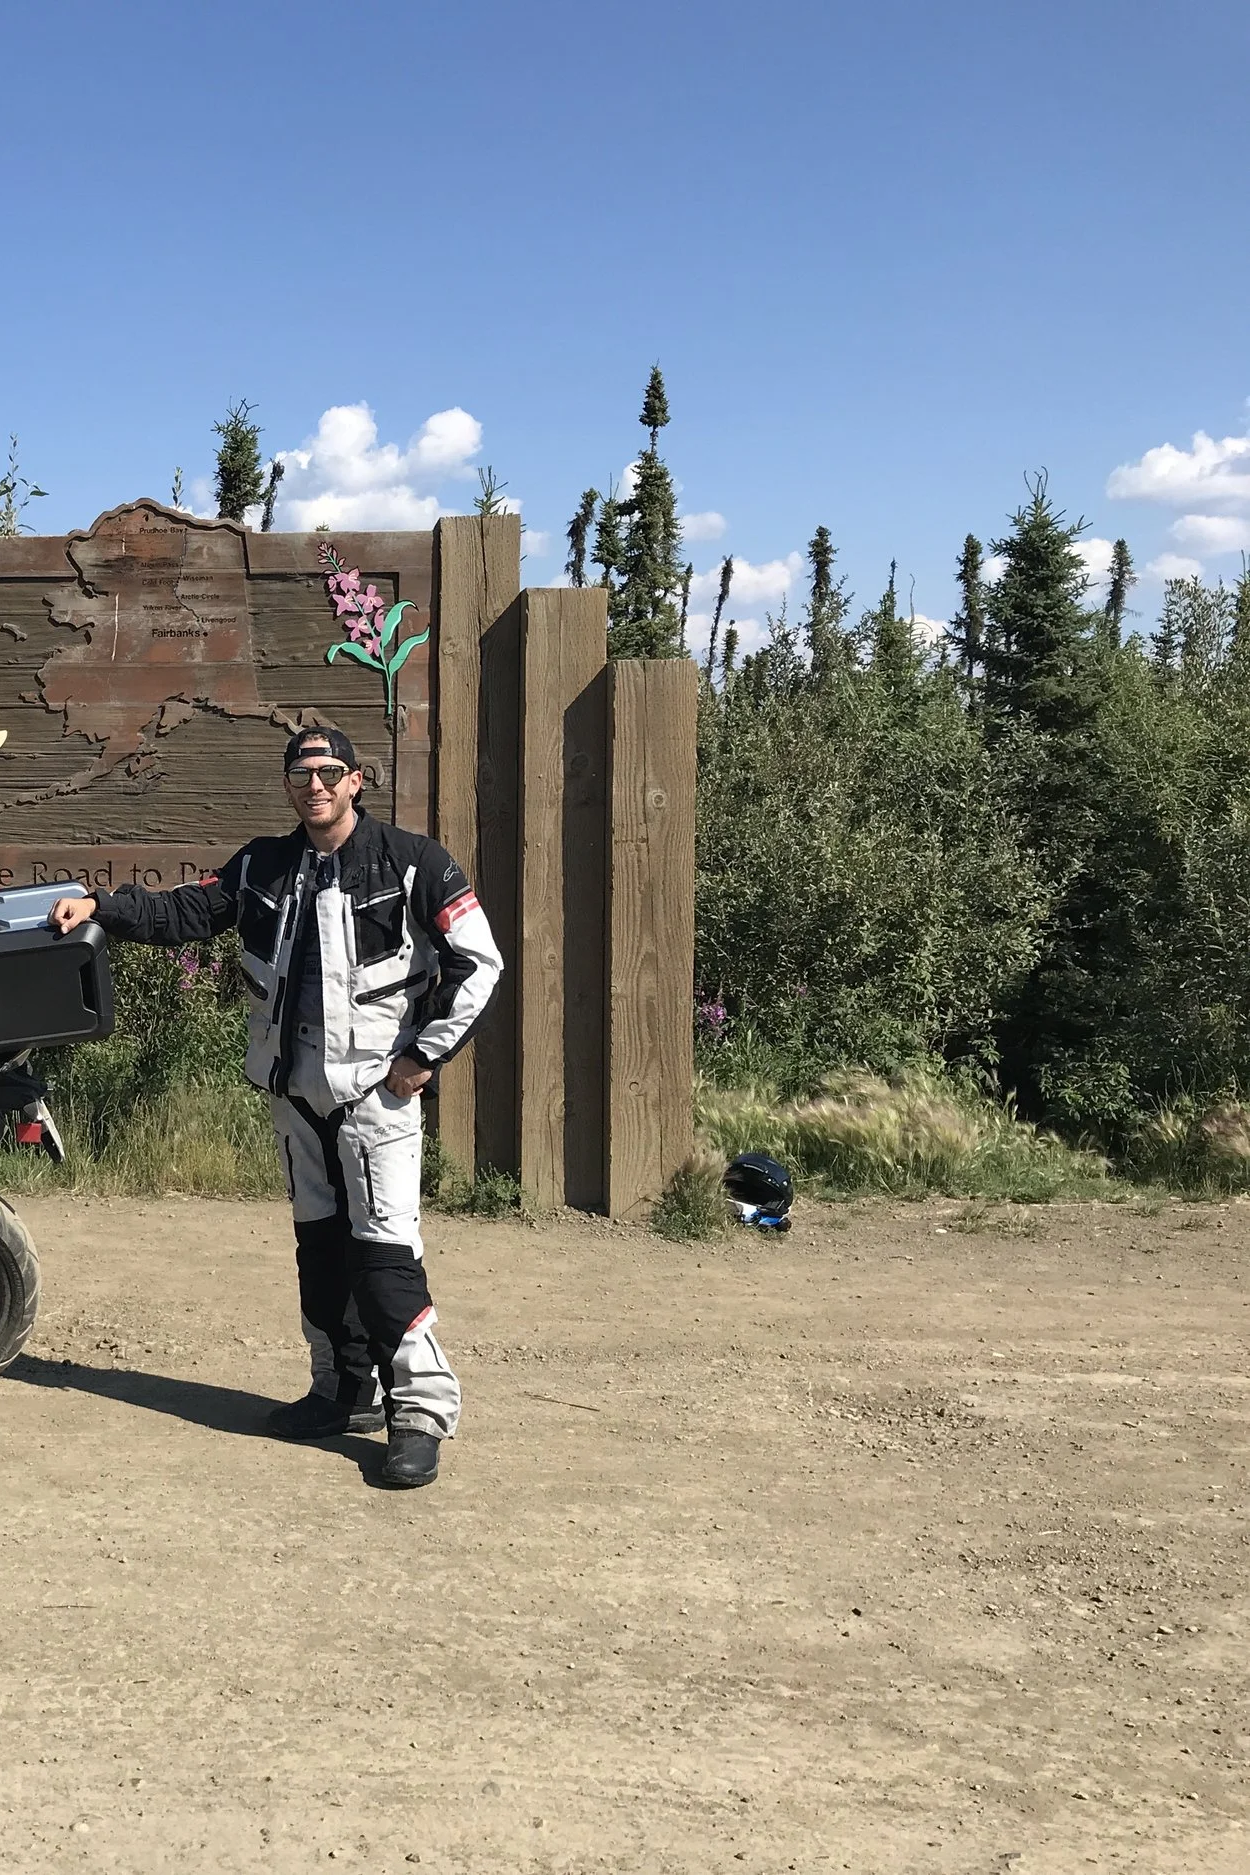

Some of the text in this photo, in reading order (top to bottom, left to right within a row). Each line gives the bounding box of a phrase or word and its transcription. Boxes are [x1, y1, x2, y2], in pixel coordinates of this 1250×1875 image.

[170, 527, 184, 535] Bay
[201, 616, 237, 624] Livengood
[151, 629, 201, 638] Fairbanks
[31, 860, 113, 887] Road
[130, 863, 162, 887] to
